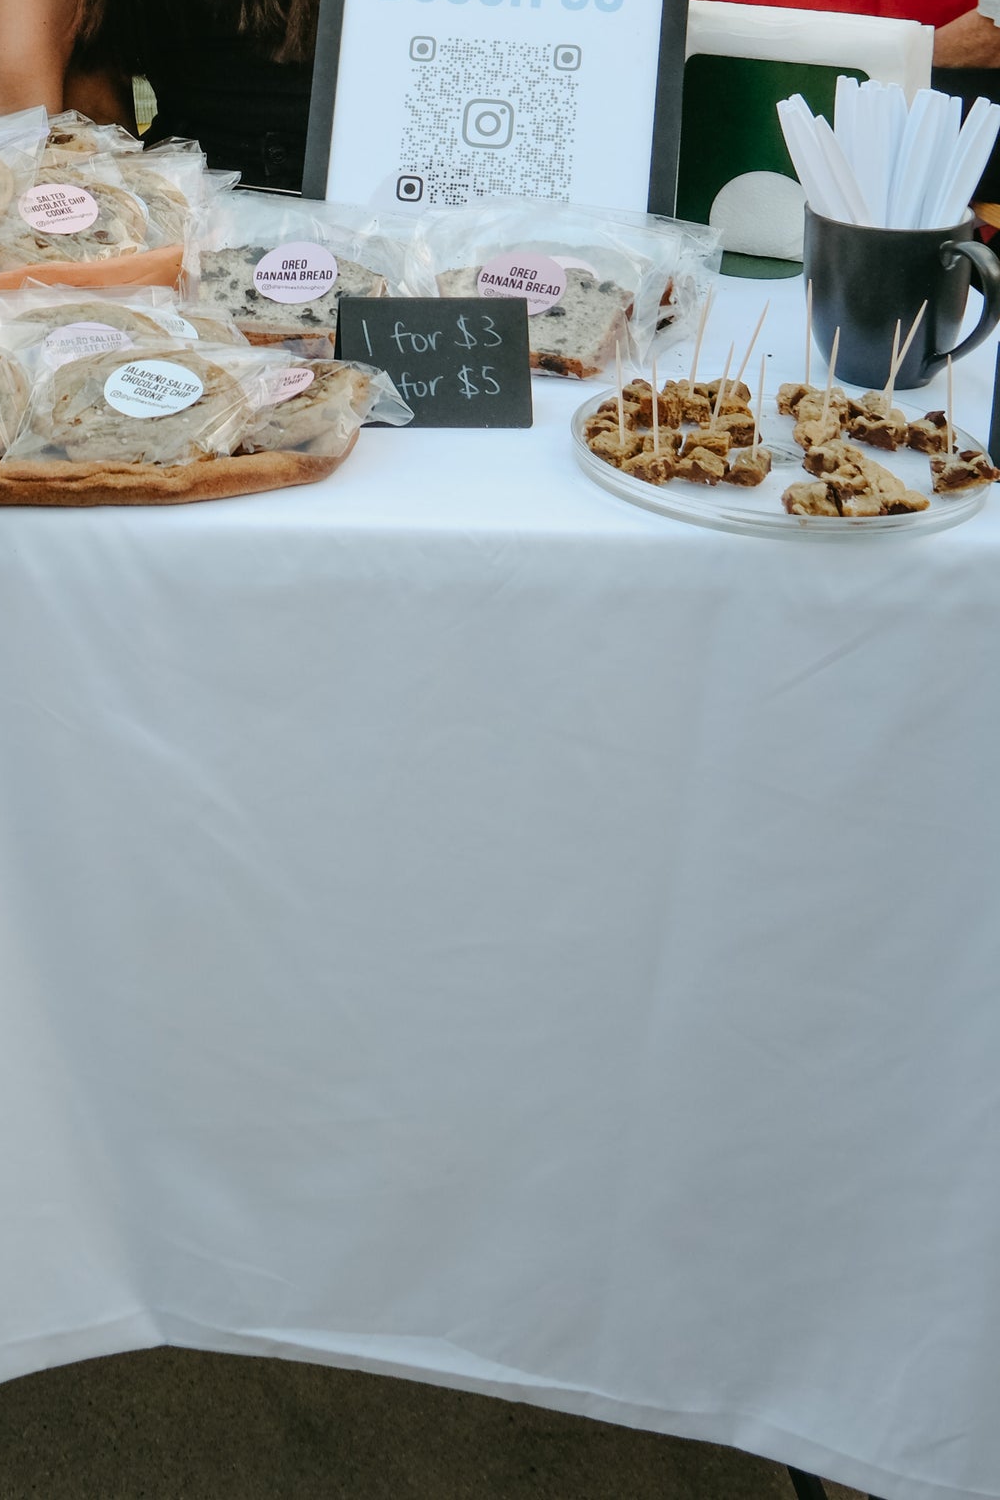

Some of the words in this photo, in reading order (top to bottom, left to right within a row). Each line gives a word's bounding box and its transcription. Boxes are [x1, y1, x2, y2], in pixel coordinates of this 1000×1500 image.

[36, 192, 66, 203] SALTED
[68, 196, 86, 206] CHIP
[45, 206, 75, 218] COOKIE
[281, 259, 308, 270] OREO
[256, 271, 297, 280] BANANA
[299, 270, 333, 280] BREAD
[509, 266, 538, 280] OREO
[481, 273, 523, 290] BANANA
[525, 281, 560, 296] BREAD
[90, 332, 123, 344] SALTED
[390, 321, 443, 353] for
[454, 314, 502, 350] $3
[124, 365, 167, 384] JALAPEÑO
[166, 379, 200, 393] SALTED
[397, 371, 444, 399] for
[457, 364, 501, 399] $5
[120, 374, 169, 395] CHOCOLATE
[169, 388, 192, 399] CHIP
[133, 386, 167, 402] COOKIE
